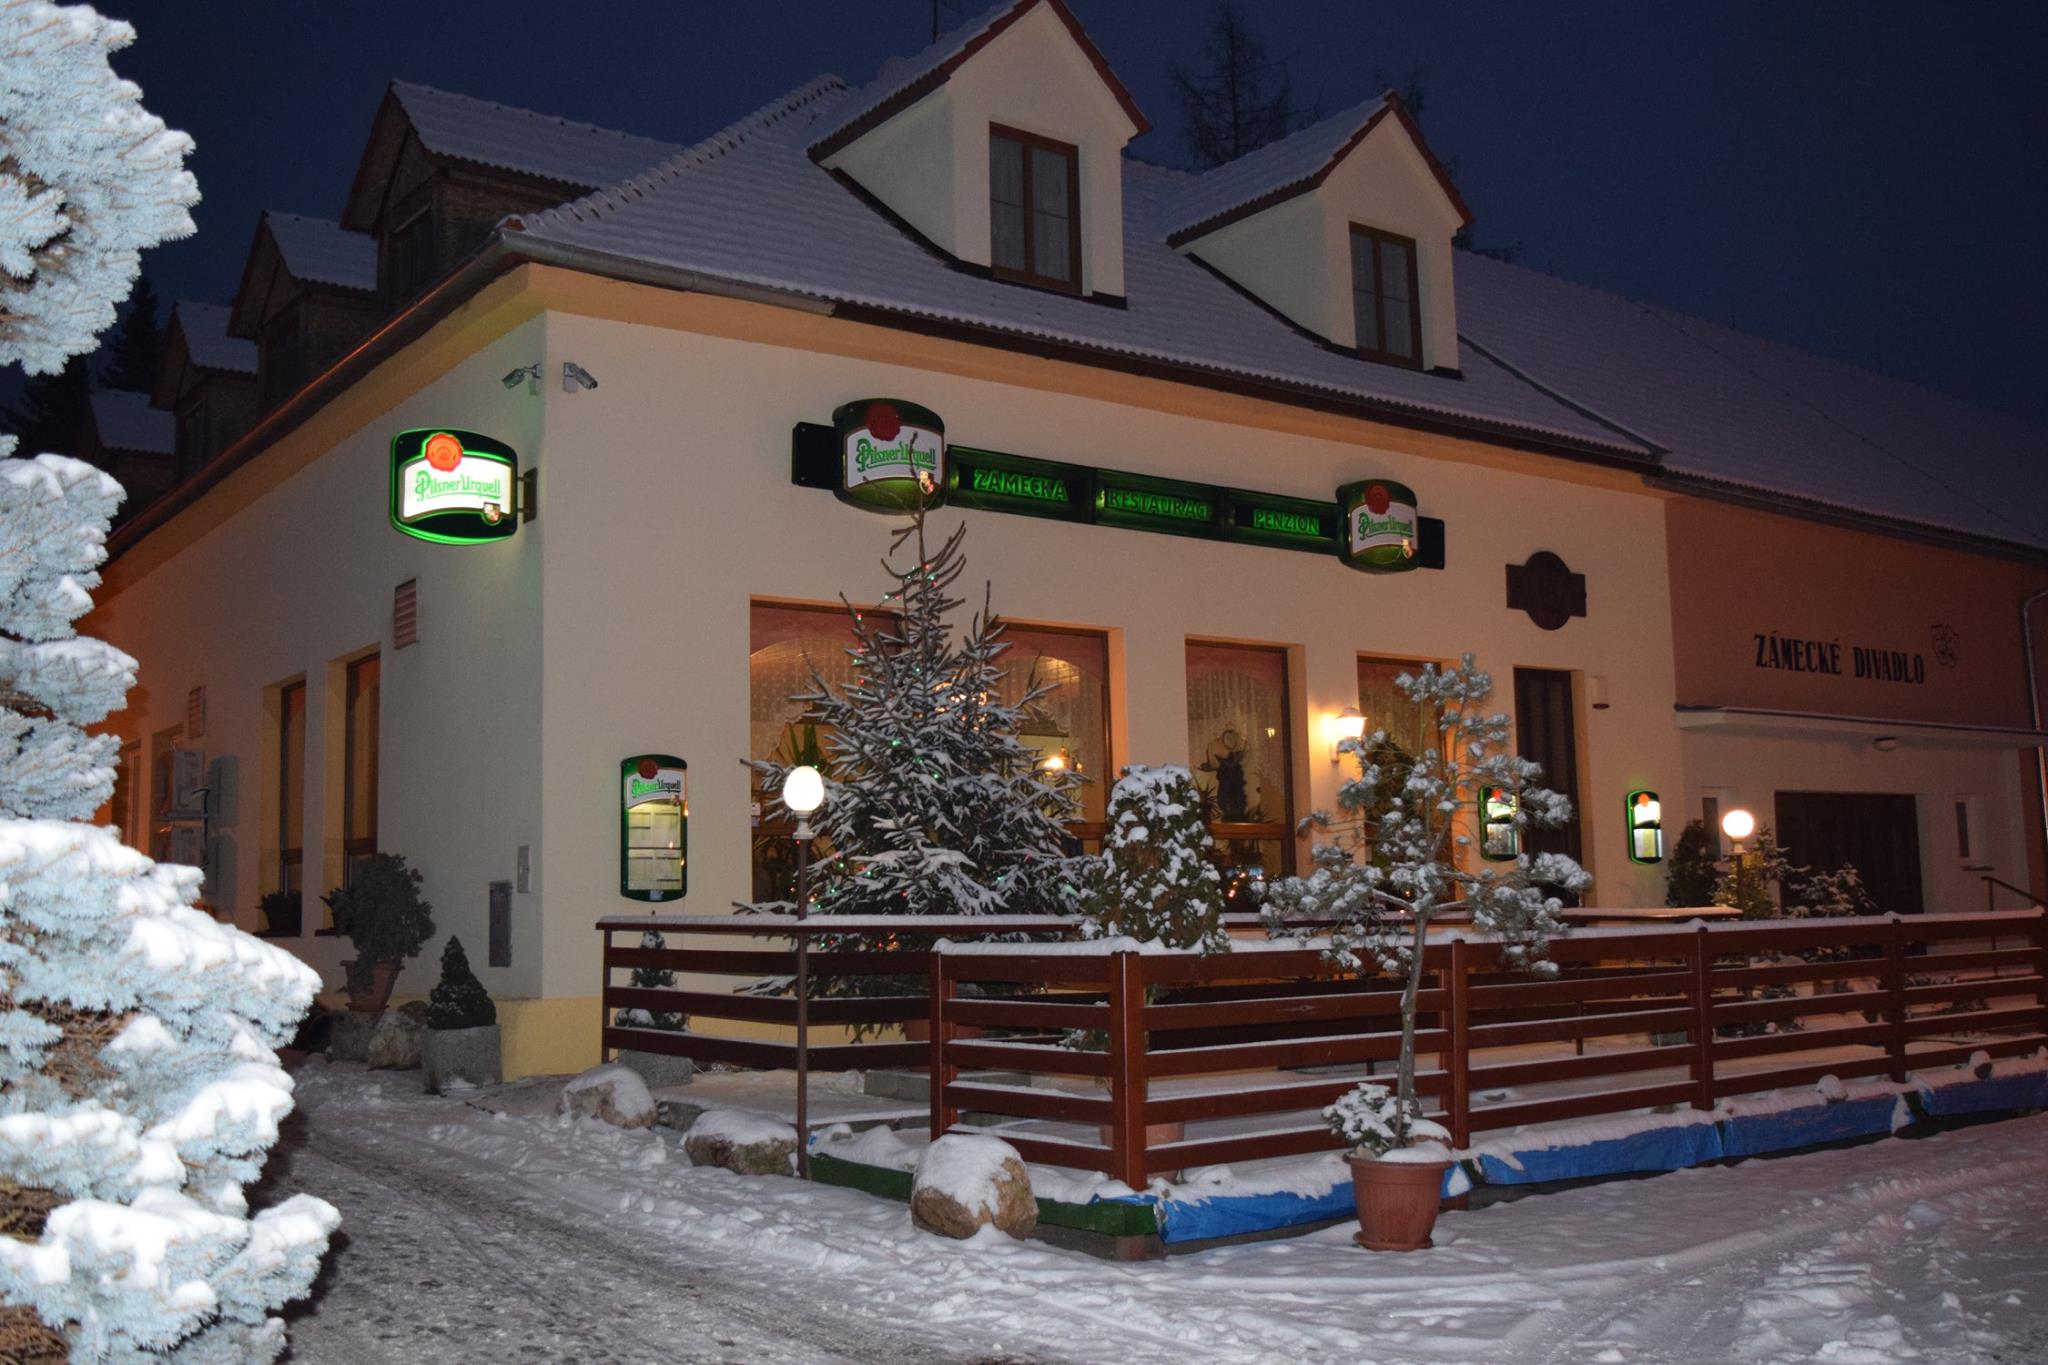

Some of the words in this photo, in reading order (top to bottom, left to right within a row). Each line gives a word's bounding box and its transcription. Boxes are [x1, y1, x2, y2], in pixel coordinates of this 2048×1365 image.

[855, 438, 900, 472] Pilsner
[415, 470, 462, 502] Pilsner
[461, 474, 501, 498] Urquell
[1253, 510, 1320, 535] PENZION
[1753, 630, 1842, 675] ZÁMECKÉ
[1853, 647, 1925, 684] DIVADLO
